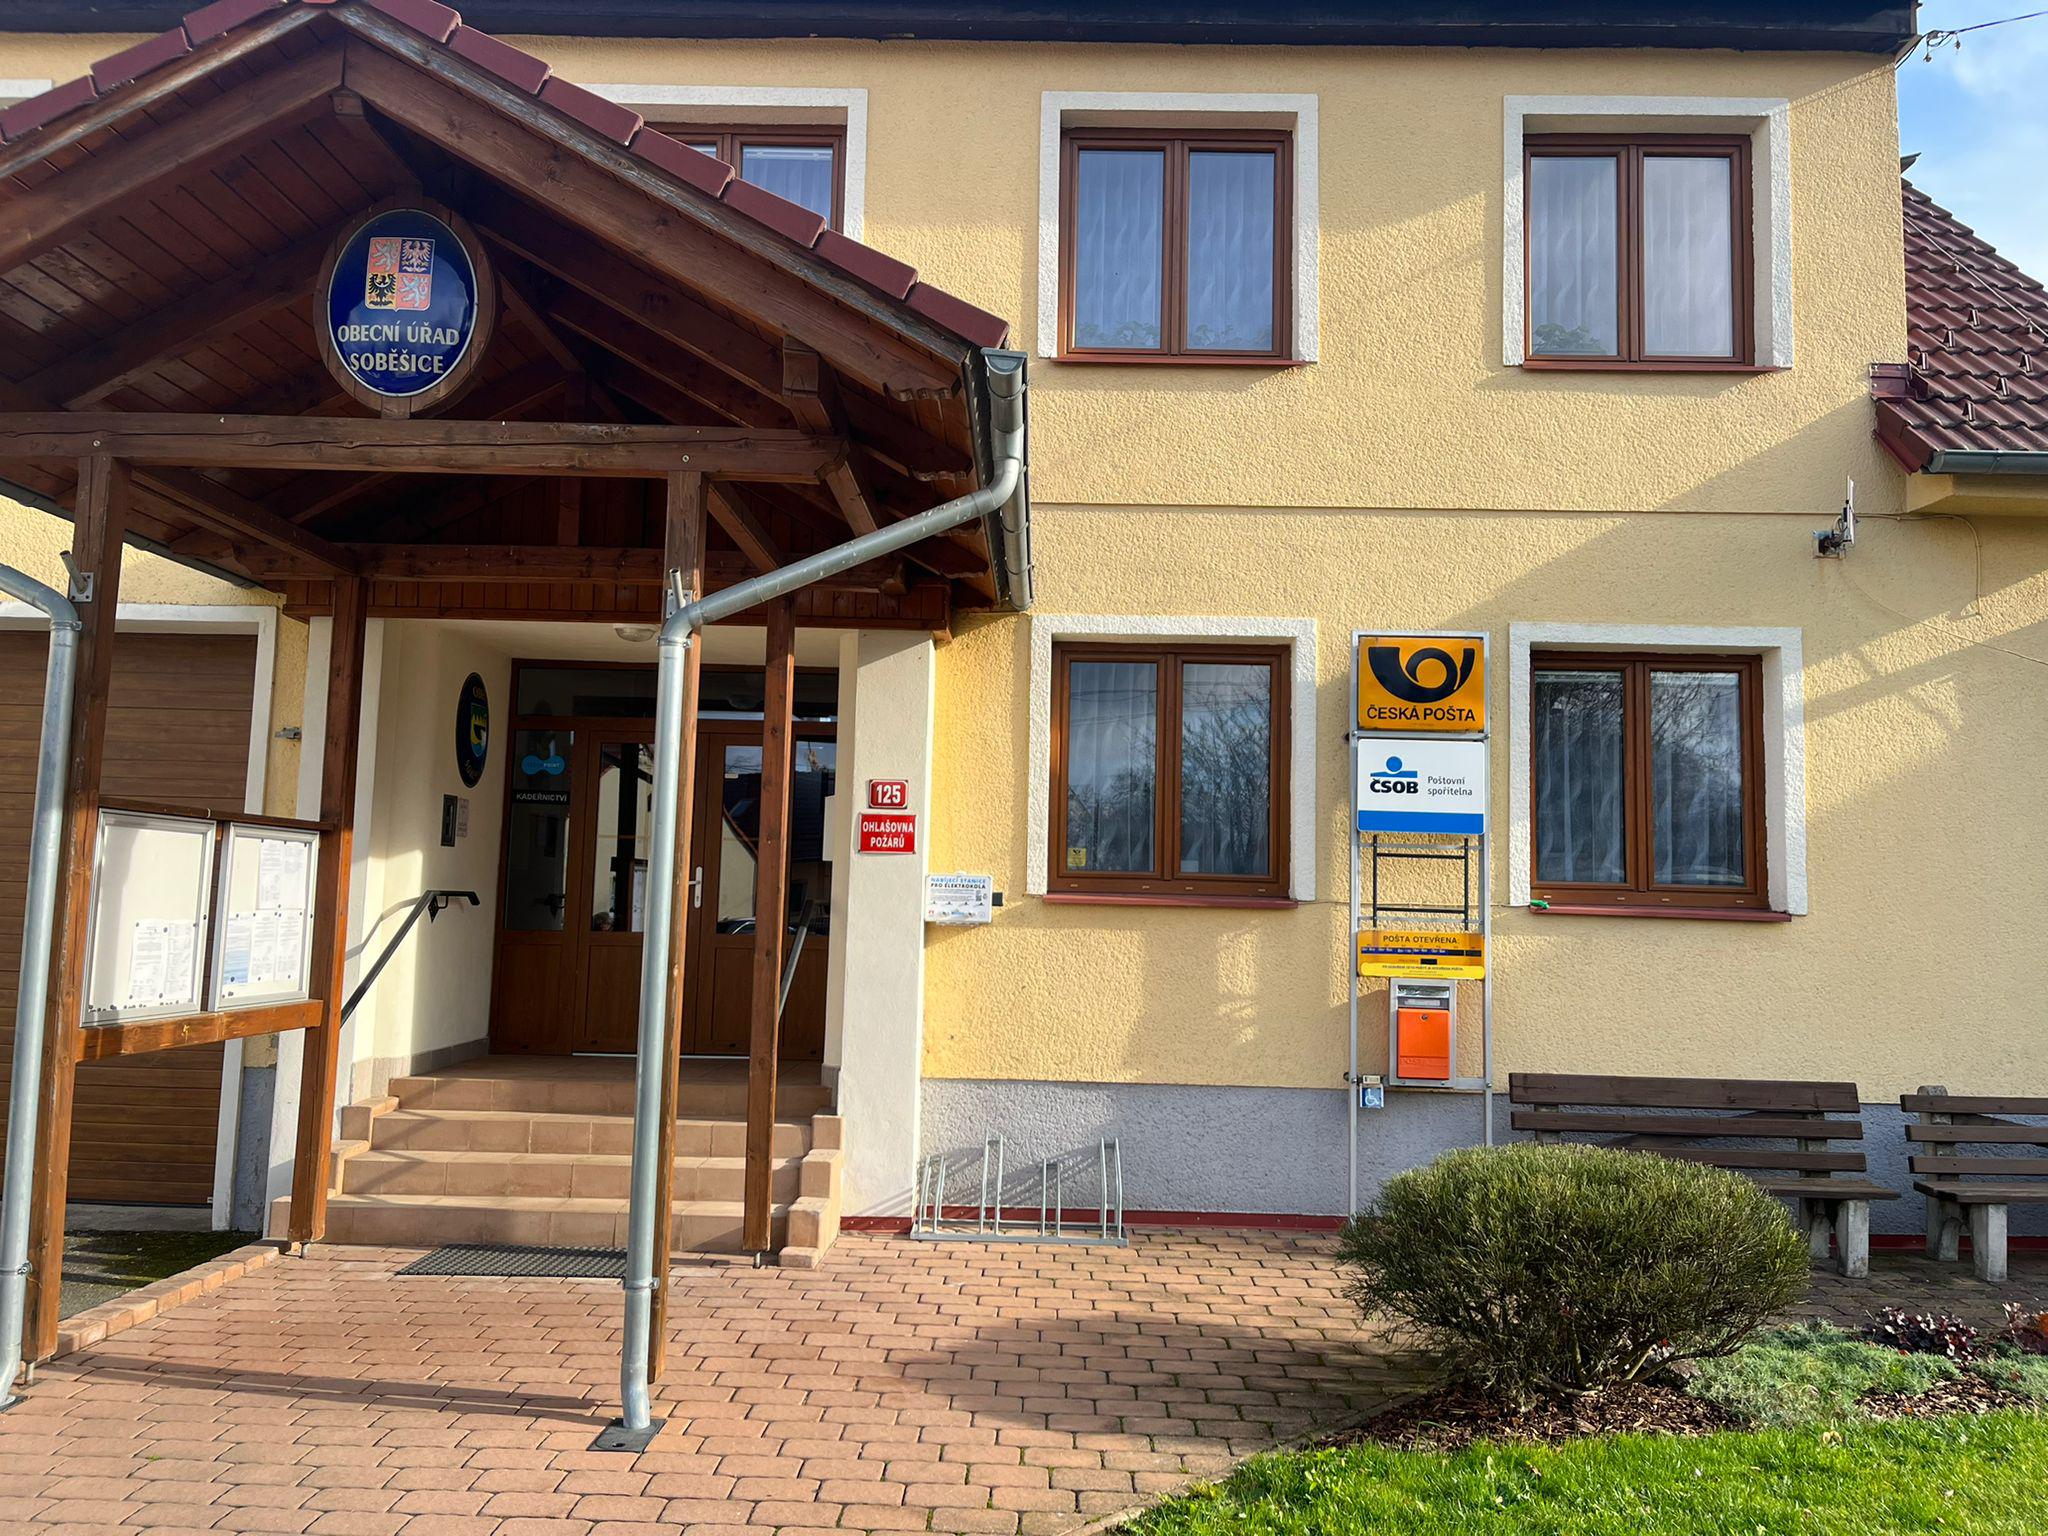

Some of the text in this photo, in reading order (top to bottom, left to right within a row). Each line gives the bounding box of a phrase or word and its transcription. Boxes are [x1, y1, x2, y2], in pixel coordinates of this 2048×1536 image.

[337, 320, 459, 345] OBECNÍ ÚŘAD
[350, 348, 444, 374] SOBĚŠICE
[1367, 704, 1476, 722] ČESKÁ POŠTA
[1370, 778, 1419, 794] ČSOB
[1427, 775, 1465, 785] Poštovní
[516, 791, 567, 802] KADEŘNICTVÍ
[876, 784, 901, 804] 125
[1427, 786, 1473, 796] spořitelna
[863, 819, 914, 833] OHLAŠOVNA
[870, 833, 905, 848] POŽÁRŮ
[1383, 935, 1411, 943] POŠTA
